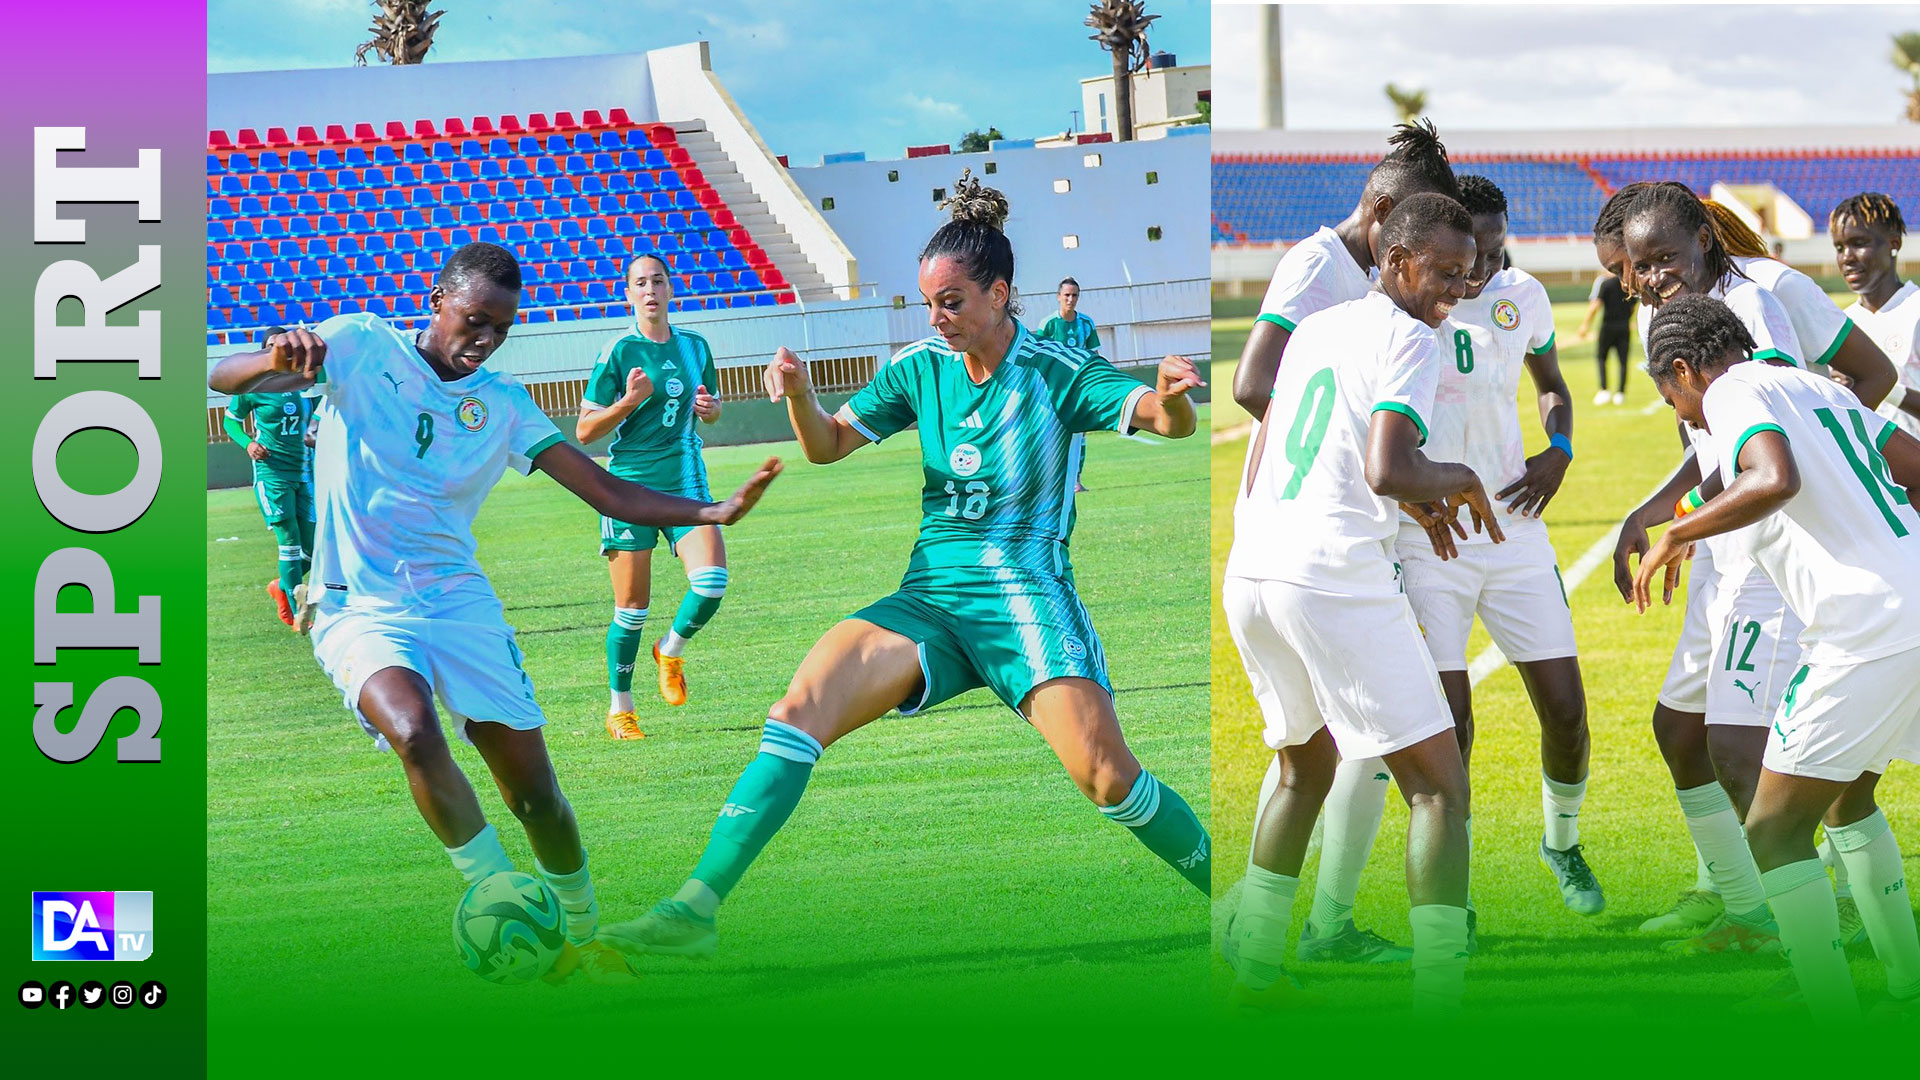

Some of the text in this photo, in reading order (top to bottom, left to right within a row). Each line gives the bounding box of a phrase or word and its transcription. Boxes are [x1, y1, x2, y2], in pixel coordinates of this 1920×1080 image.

[1454, 329, 1474, 374] 8
[280, 415, 300, 436] 12
[415, 412, 434, 460] 9
[662, 399, 680, 427] 8
[1280, 367, 1337, 500] 9
[1812, 407, 1911, 539] 14
[943, 480, 991, 520] 18
[1725, 620, 1762, 672] 12
